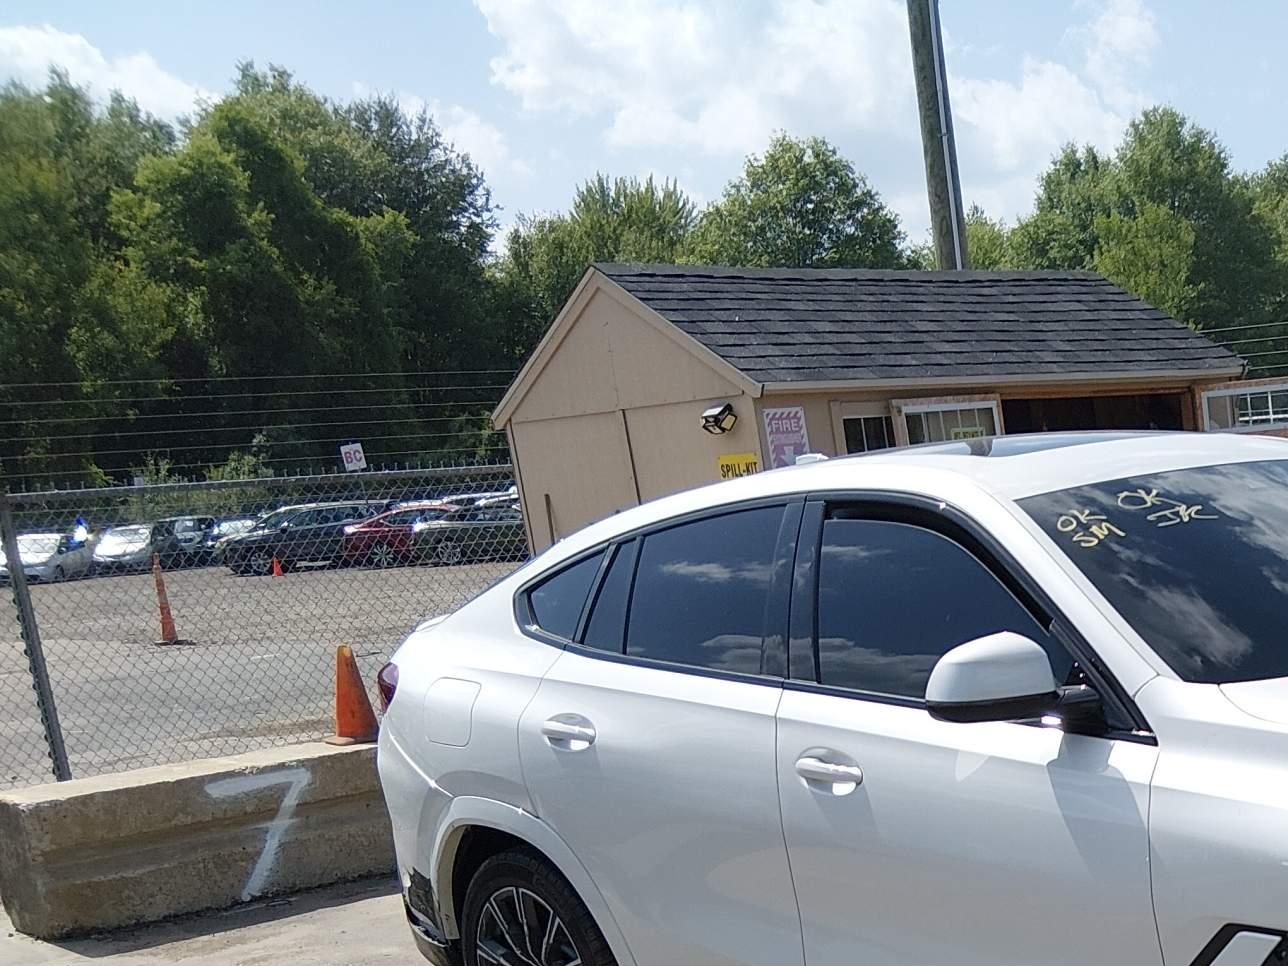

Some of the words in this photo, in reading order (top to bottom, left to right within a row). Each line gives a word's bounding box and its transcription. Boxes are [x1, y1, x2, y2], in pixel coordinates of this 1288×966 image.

[772, 419, 800, 433] FIRE
[344, 449, 363, 464] BC
[720, 461, 758, 479] SPILL-KIT
[1056, 508, 1108, 532] OK
[1072, 521, 1127, 548] SM
[203, 767, 313, 902] 7
